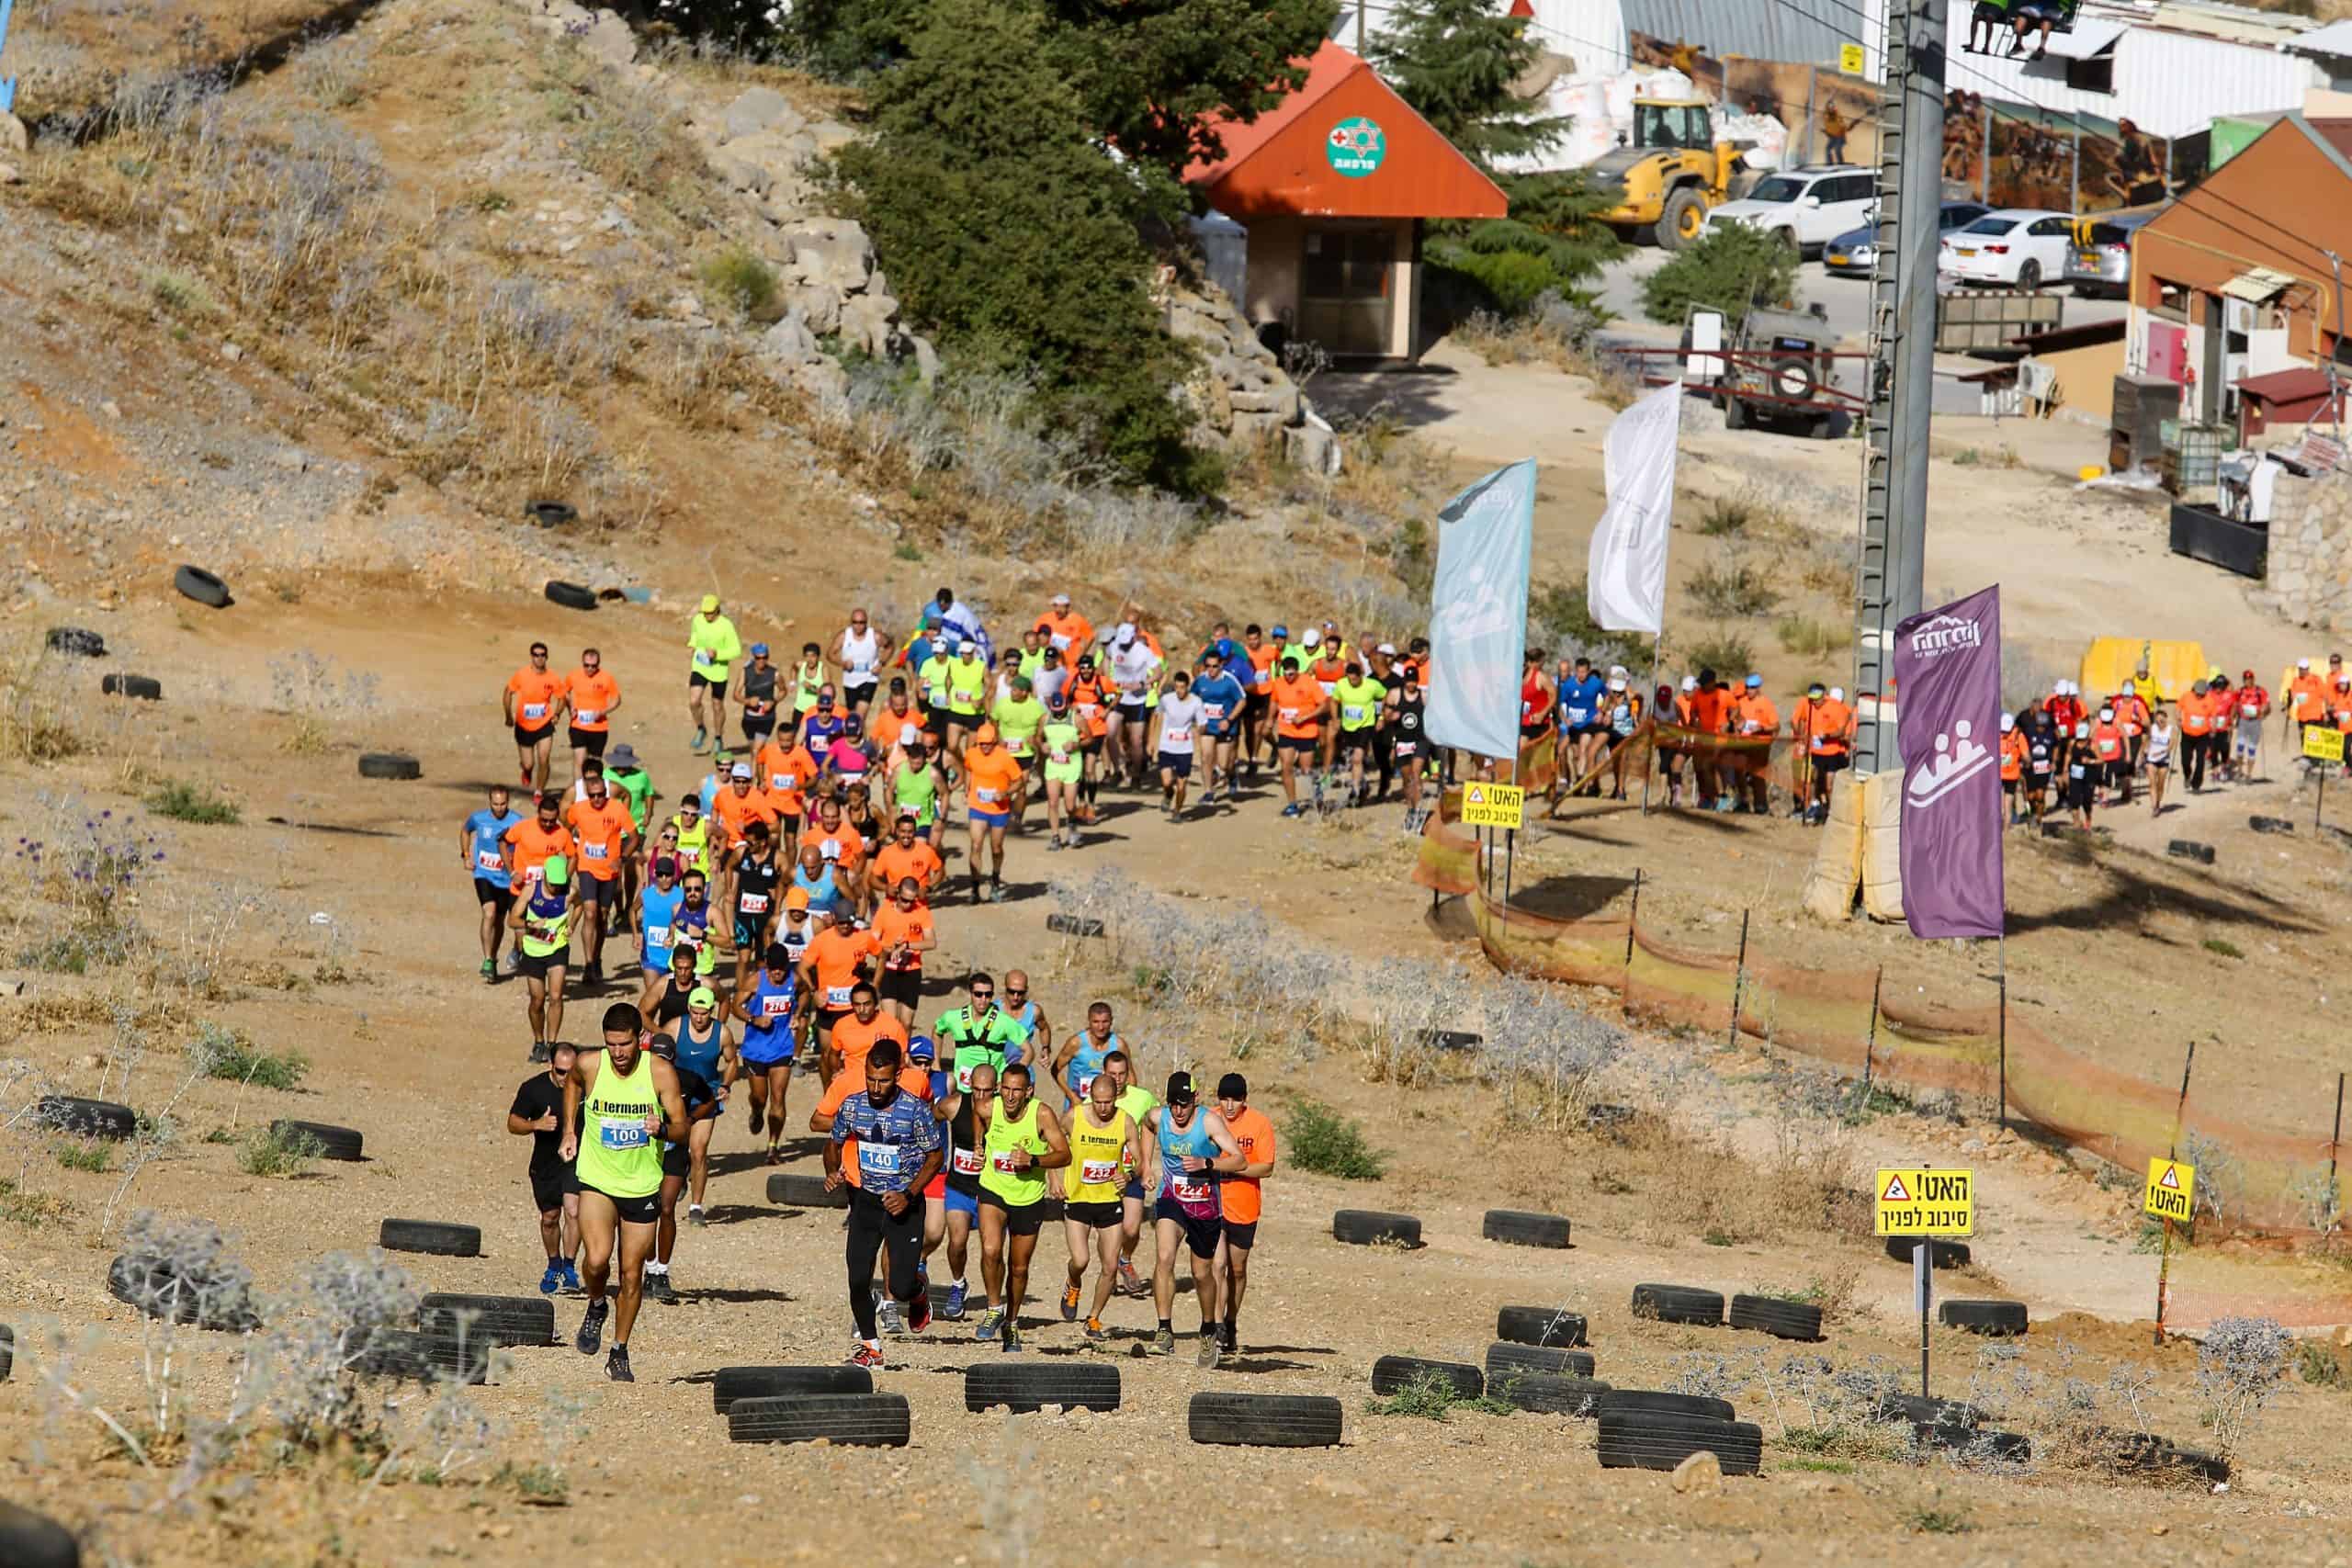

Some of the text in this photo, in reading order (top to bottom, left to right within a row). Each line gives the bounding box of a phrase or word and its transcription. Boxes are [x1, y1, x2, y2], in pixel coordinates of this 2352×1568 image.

[1488, 786, 1521, 807] האט!
[610, 1129, 639, 1142] 100
[866, 1152, 892, 1167] 140
[1089, 1168, 1111, 1178] 232
[1180, 1184, 1204, 1196] 222
[1917, 1172, 1968, 1201] האט!
[2148, 1186, 2186, 1215] האט!
[1881, 1207, 1967, 1227] סיבוב לפניך
